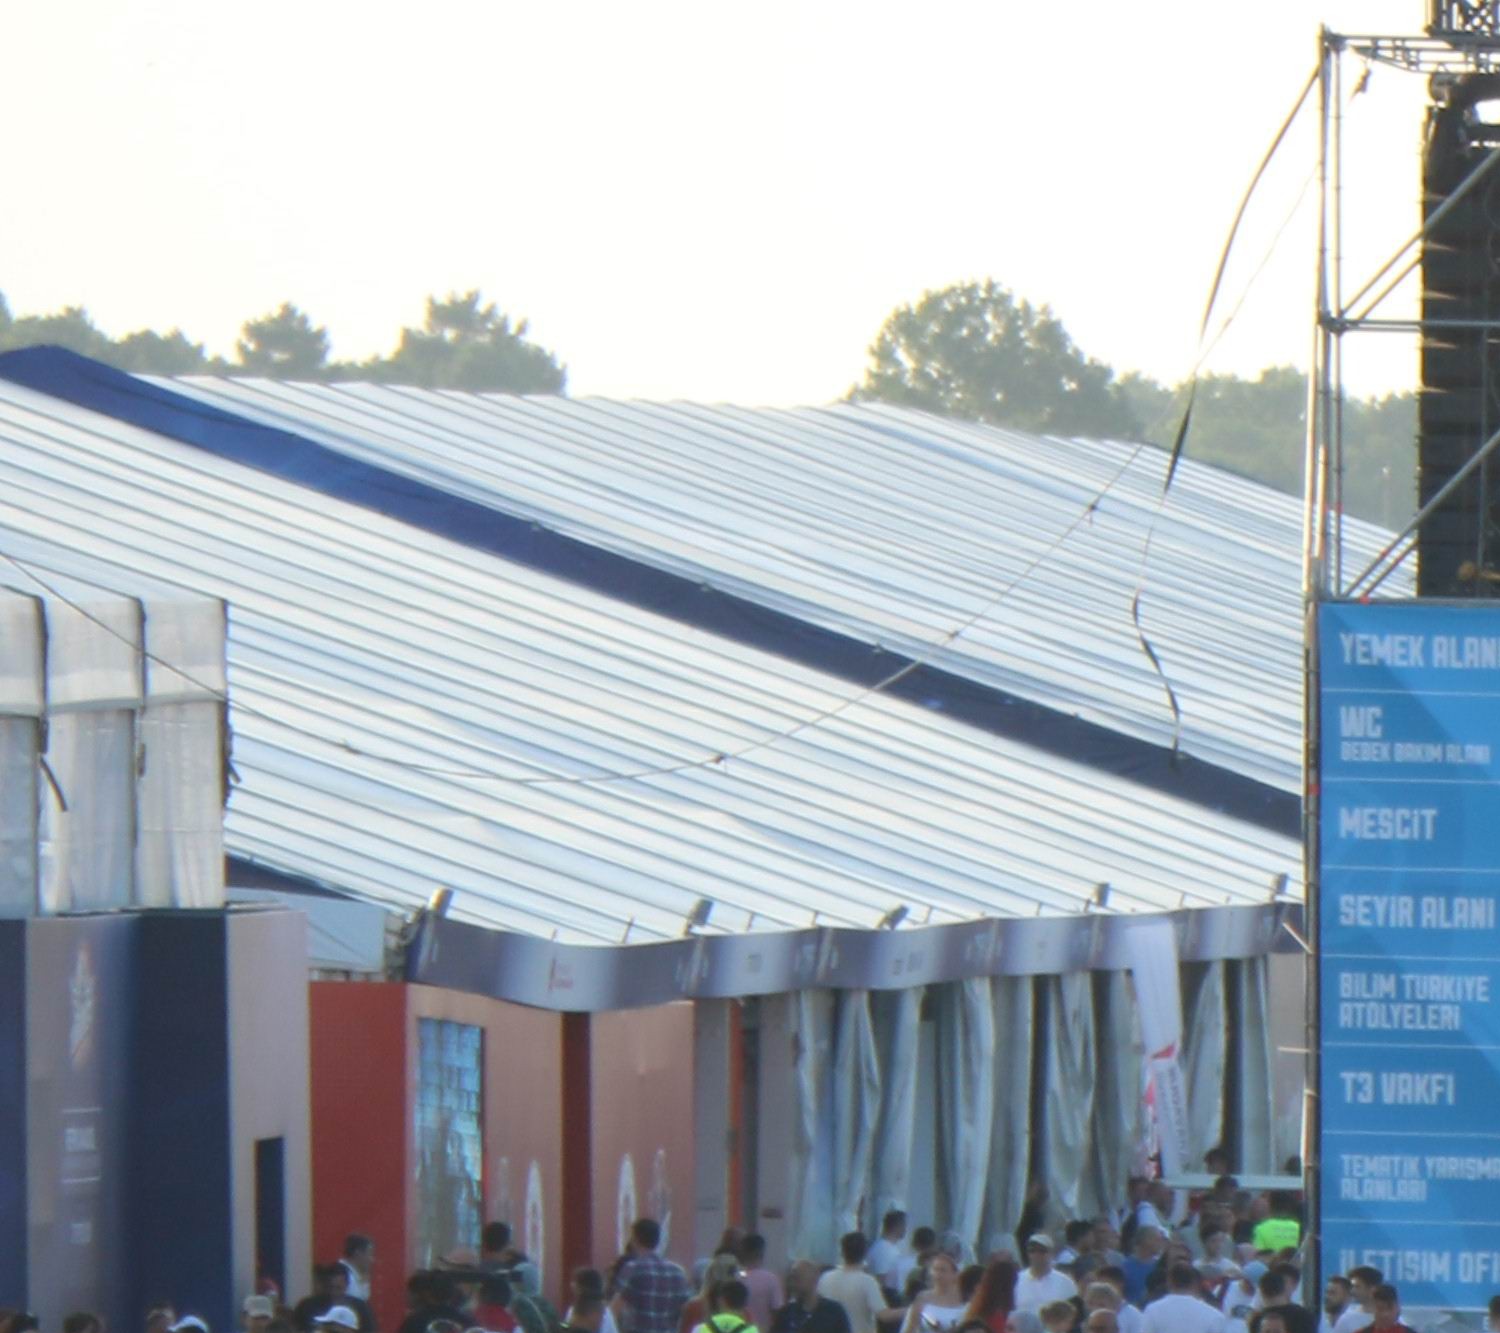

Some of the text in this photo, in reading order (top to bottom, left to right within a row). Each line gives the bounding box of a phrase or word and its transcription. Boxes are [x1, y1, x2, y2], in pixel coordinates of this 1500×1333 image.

[1339, 631, 1424, 668] YEMEK
[1339, 705, 1383, 738] WC
[1421, 895, 1496, 929] ALANI
[1340, 1070, 1455, 1106] T3 VAKFI
